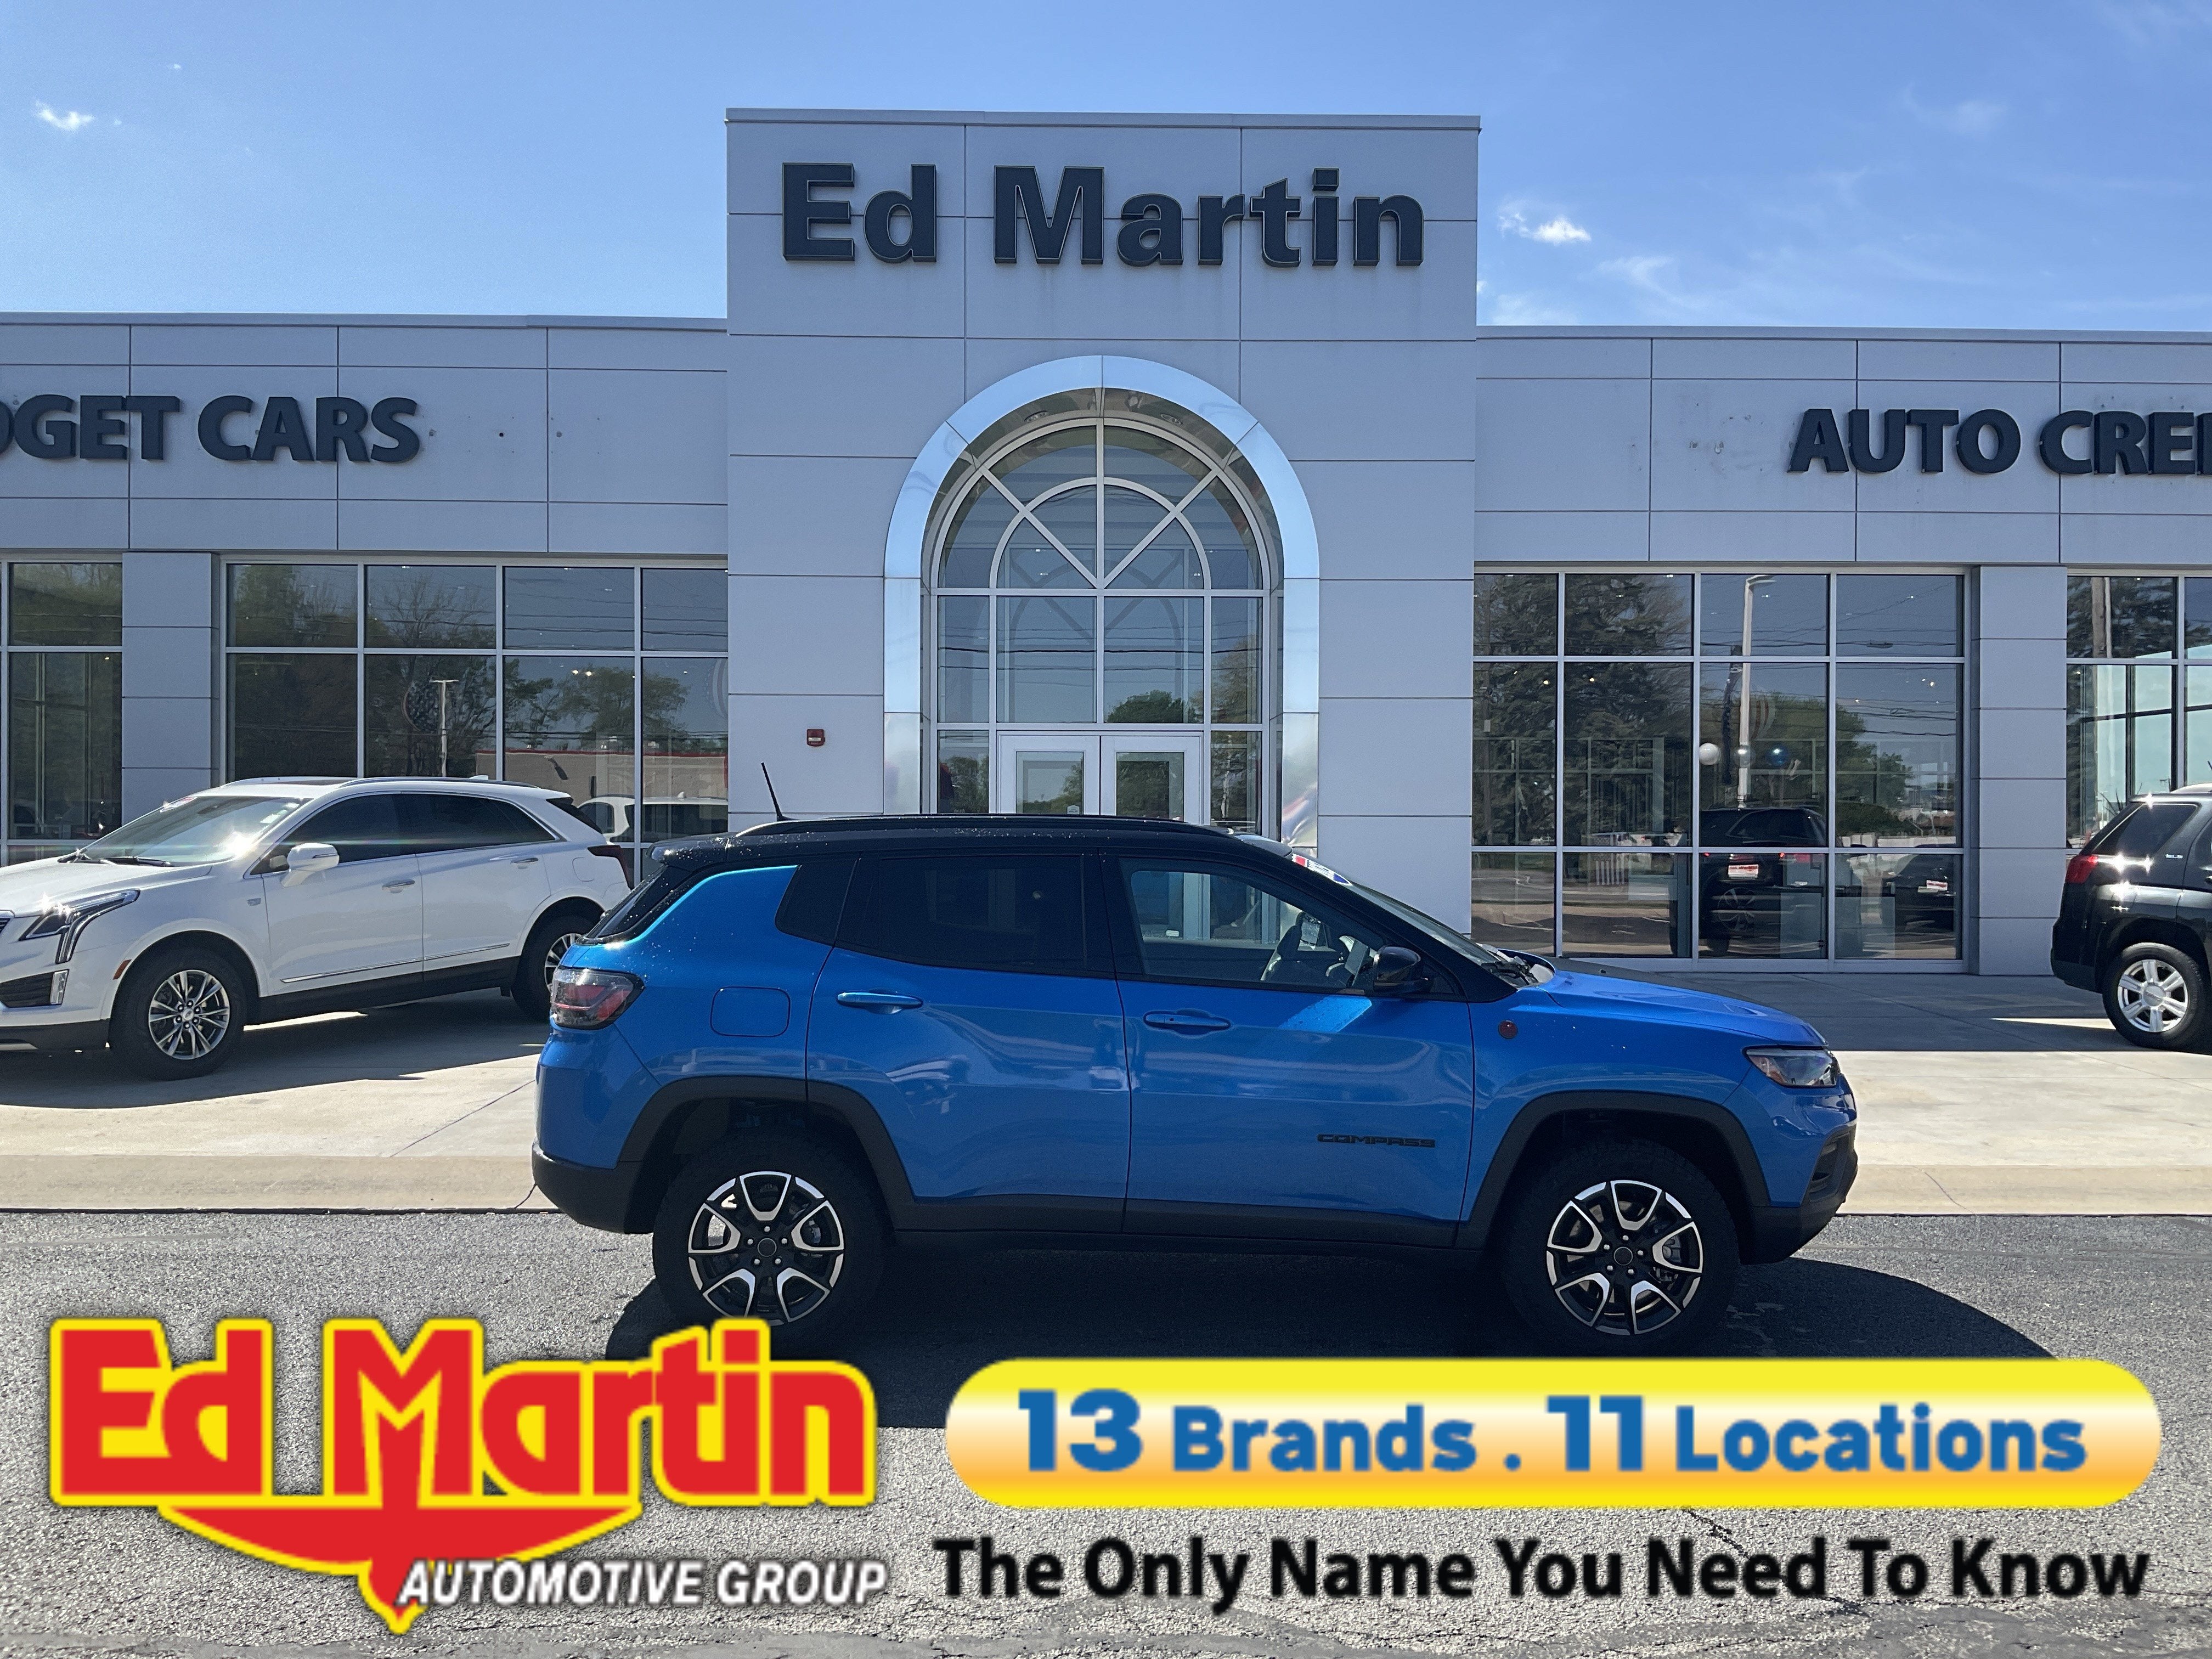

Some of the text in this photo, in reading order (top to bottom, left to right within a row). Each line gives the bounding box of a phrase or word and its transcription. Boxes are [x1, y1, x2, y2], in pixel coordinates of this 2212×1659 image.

[782, 163, 1424, 268] Ed Martin
[0, 394, 420, 463] GET CARS
[1787, 408, 2021, 475] AUTO
[1317, 1133, 1436, 1148] COMPASS
